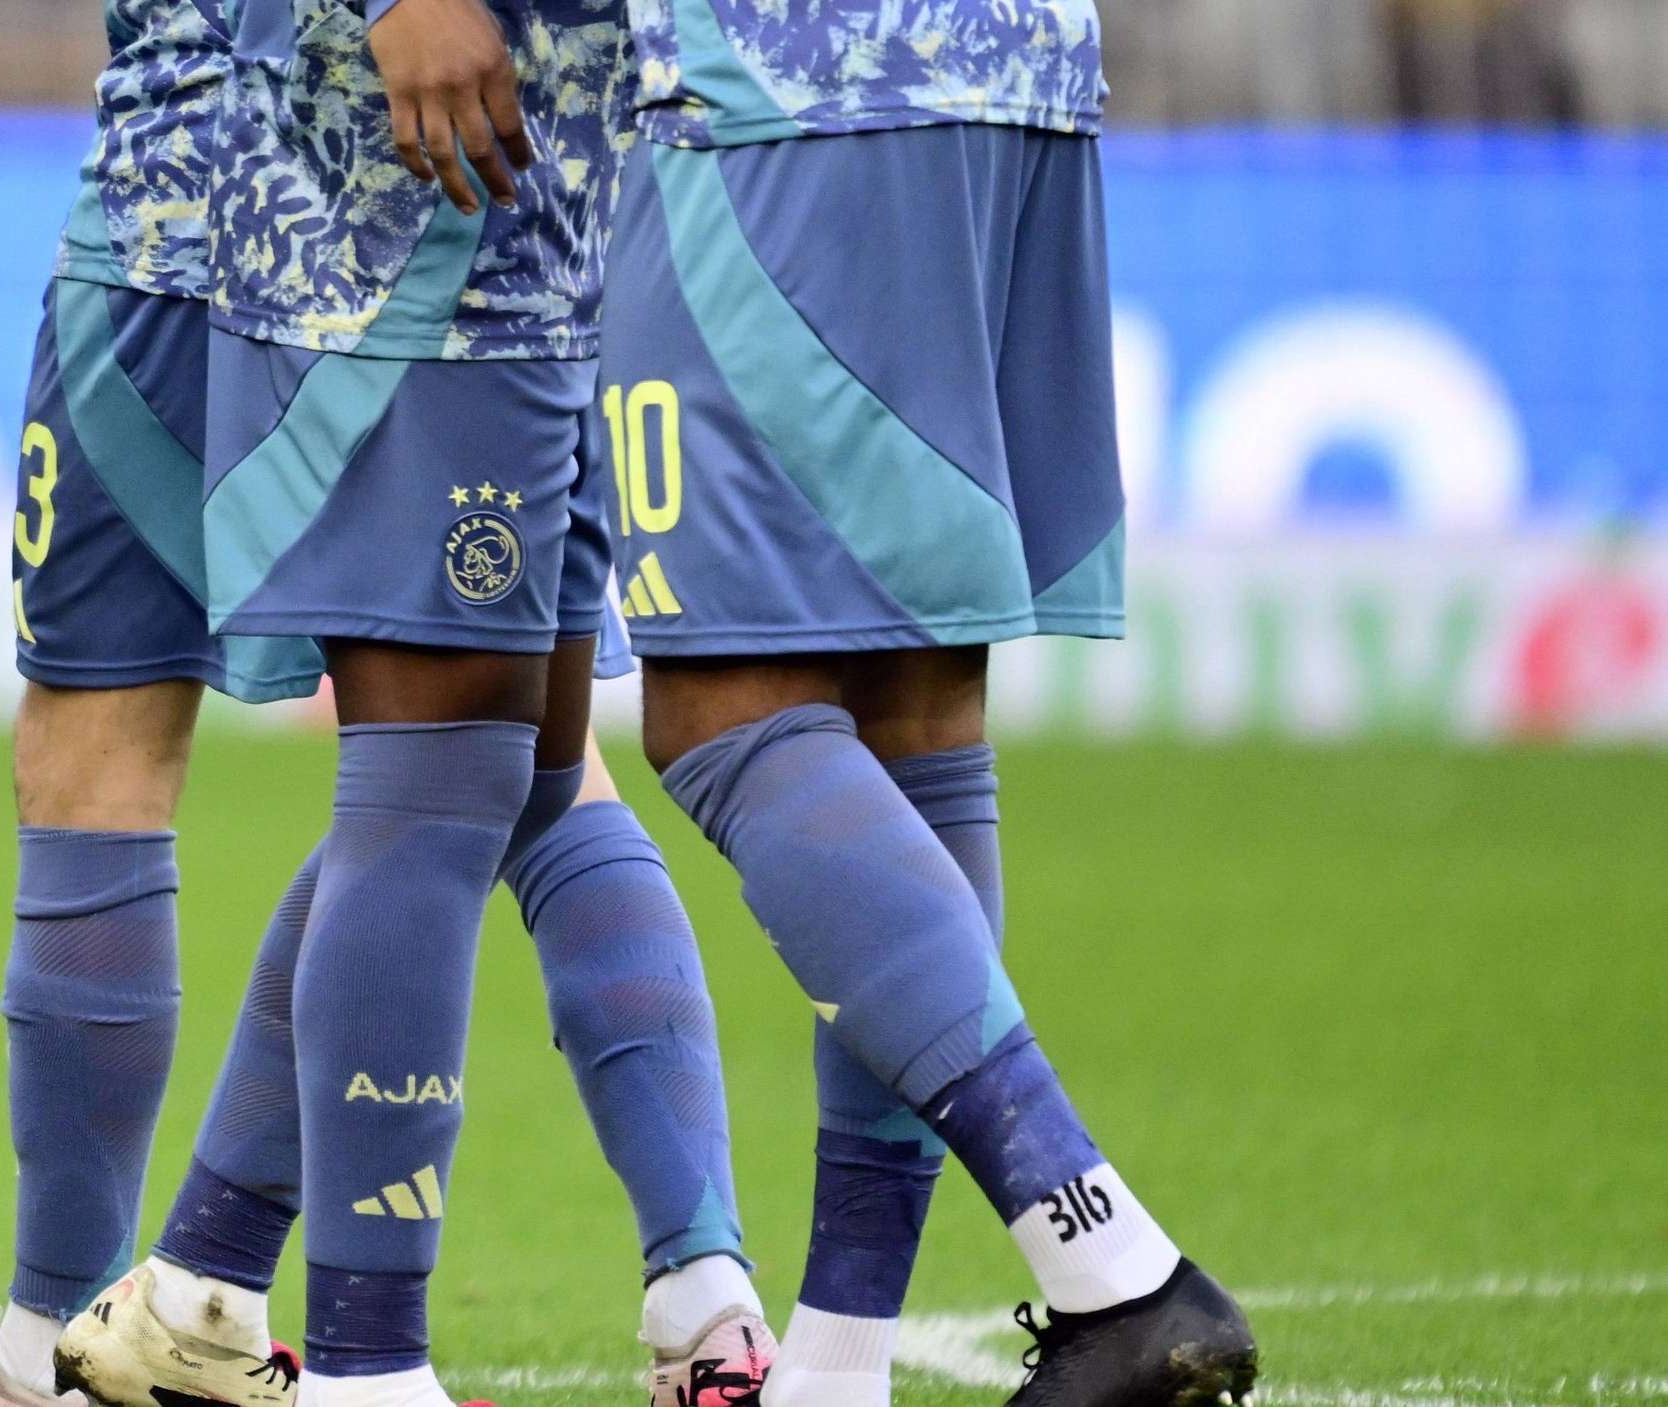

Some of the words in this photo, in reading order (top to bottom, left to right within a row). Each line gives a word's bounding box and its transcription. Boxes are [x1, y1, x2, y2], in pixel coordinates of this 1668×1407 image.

[603, 380, 681, 537] 10
[15, 421, 58, 568] 3
[446, 517, 482, 554] AJAX
[345, 1072, 464, 1105] AJAX
[1040, 1176, 1113, 1243] 316
